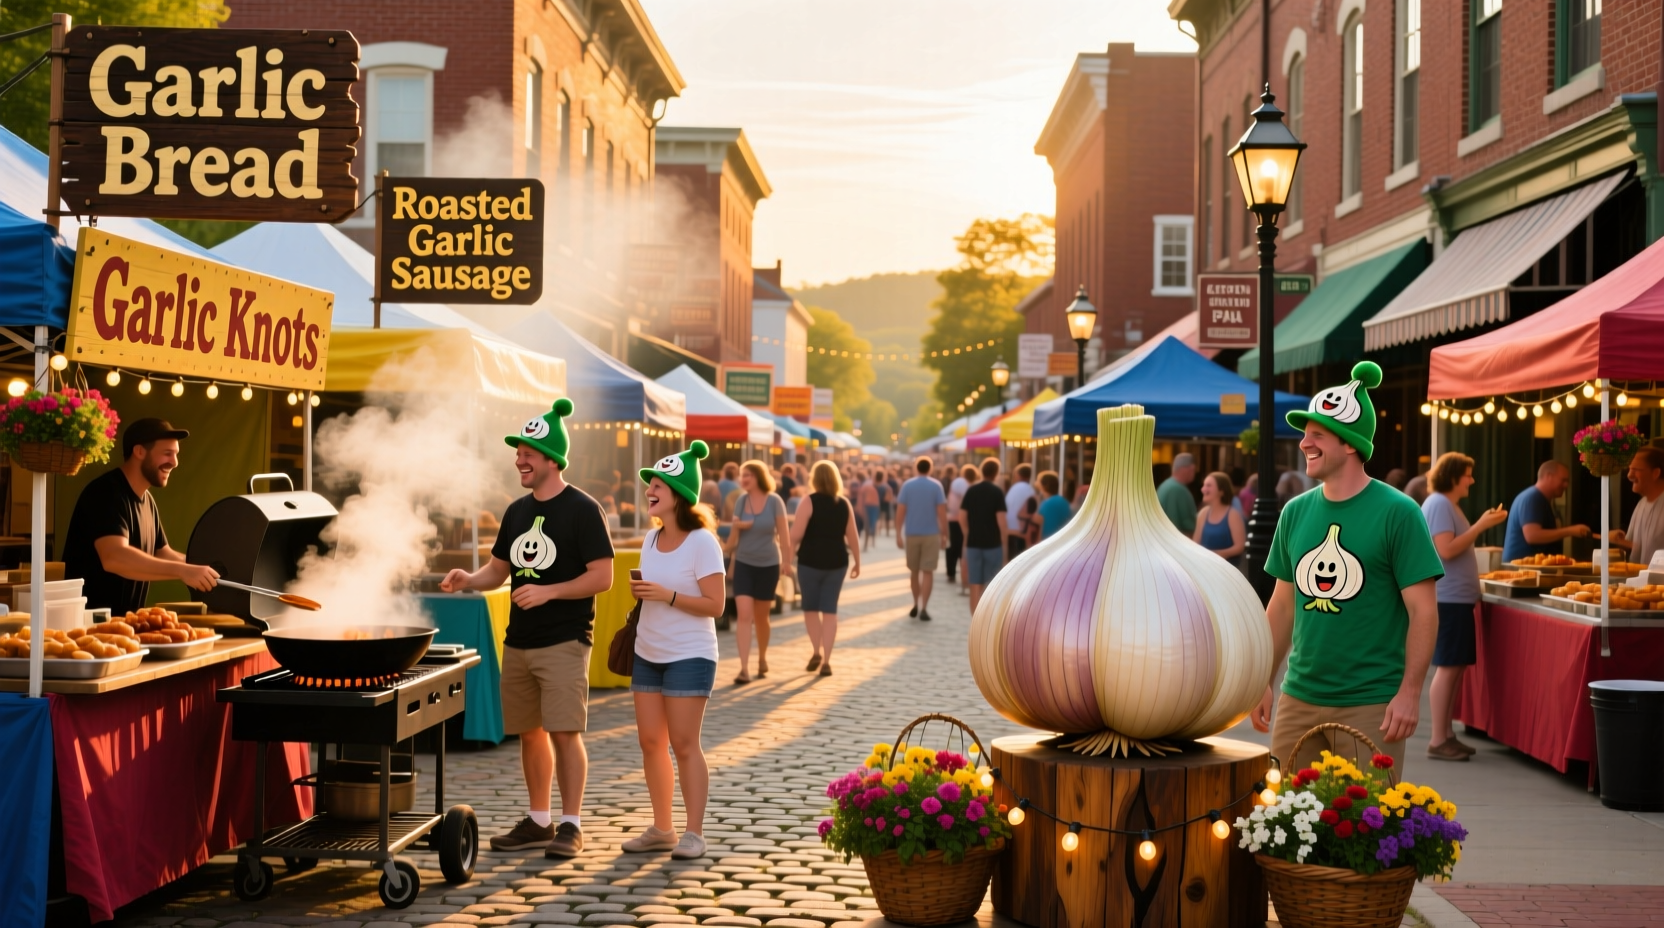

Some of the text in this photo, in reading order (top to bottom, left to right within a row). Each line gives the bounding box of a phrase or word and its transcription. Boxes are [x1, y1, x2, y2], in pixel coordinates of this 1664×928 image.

[90, 45, 325, 120] Garlic
[99, 126, 323, 199] Bread
[393, 187, 533, 220] Roasted
[409, 224, 513, 256] Garlic
[392, 257, 530, 299] Sausage
[93, 257, 319, 370] Garlic Knots
